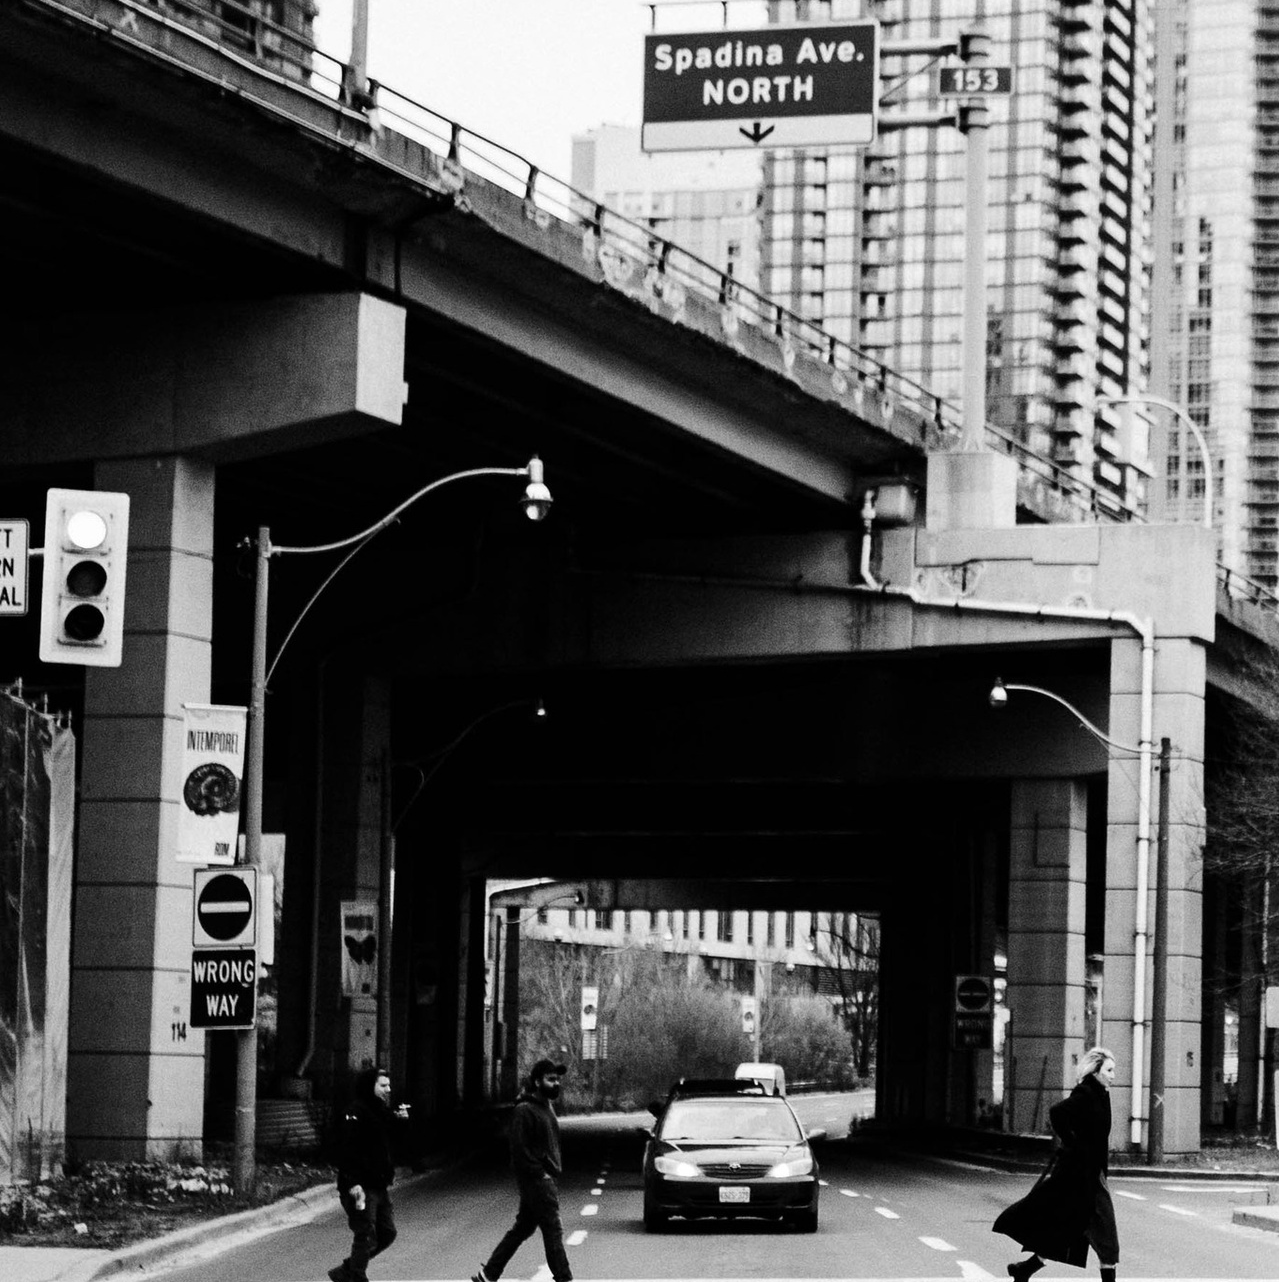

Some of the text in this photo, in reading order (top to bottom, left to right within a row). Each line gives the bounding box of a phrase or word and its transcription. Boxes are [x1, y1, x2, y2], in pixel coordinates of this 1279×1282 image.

[653, 37, 866, 75] Spadina Ave.
[702, 75, 814, 106] NORTH
[952, 70, 1000, 92] 153
[187, 730, 239, 754] INTEMPOREL
[193, 959, 255, 983] WRONG
[206, 993, 239, 1017] WAY
